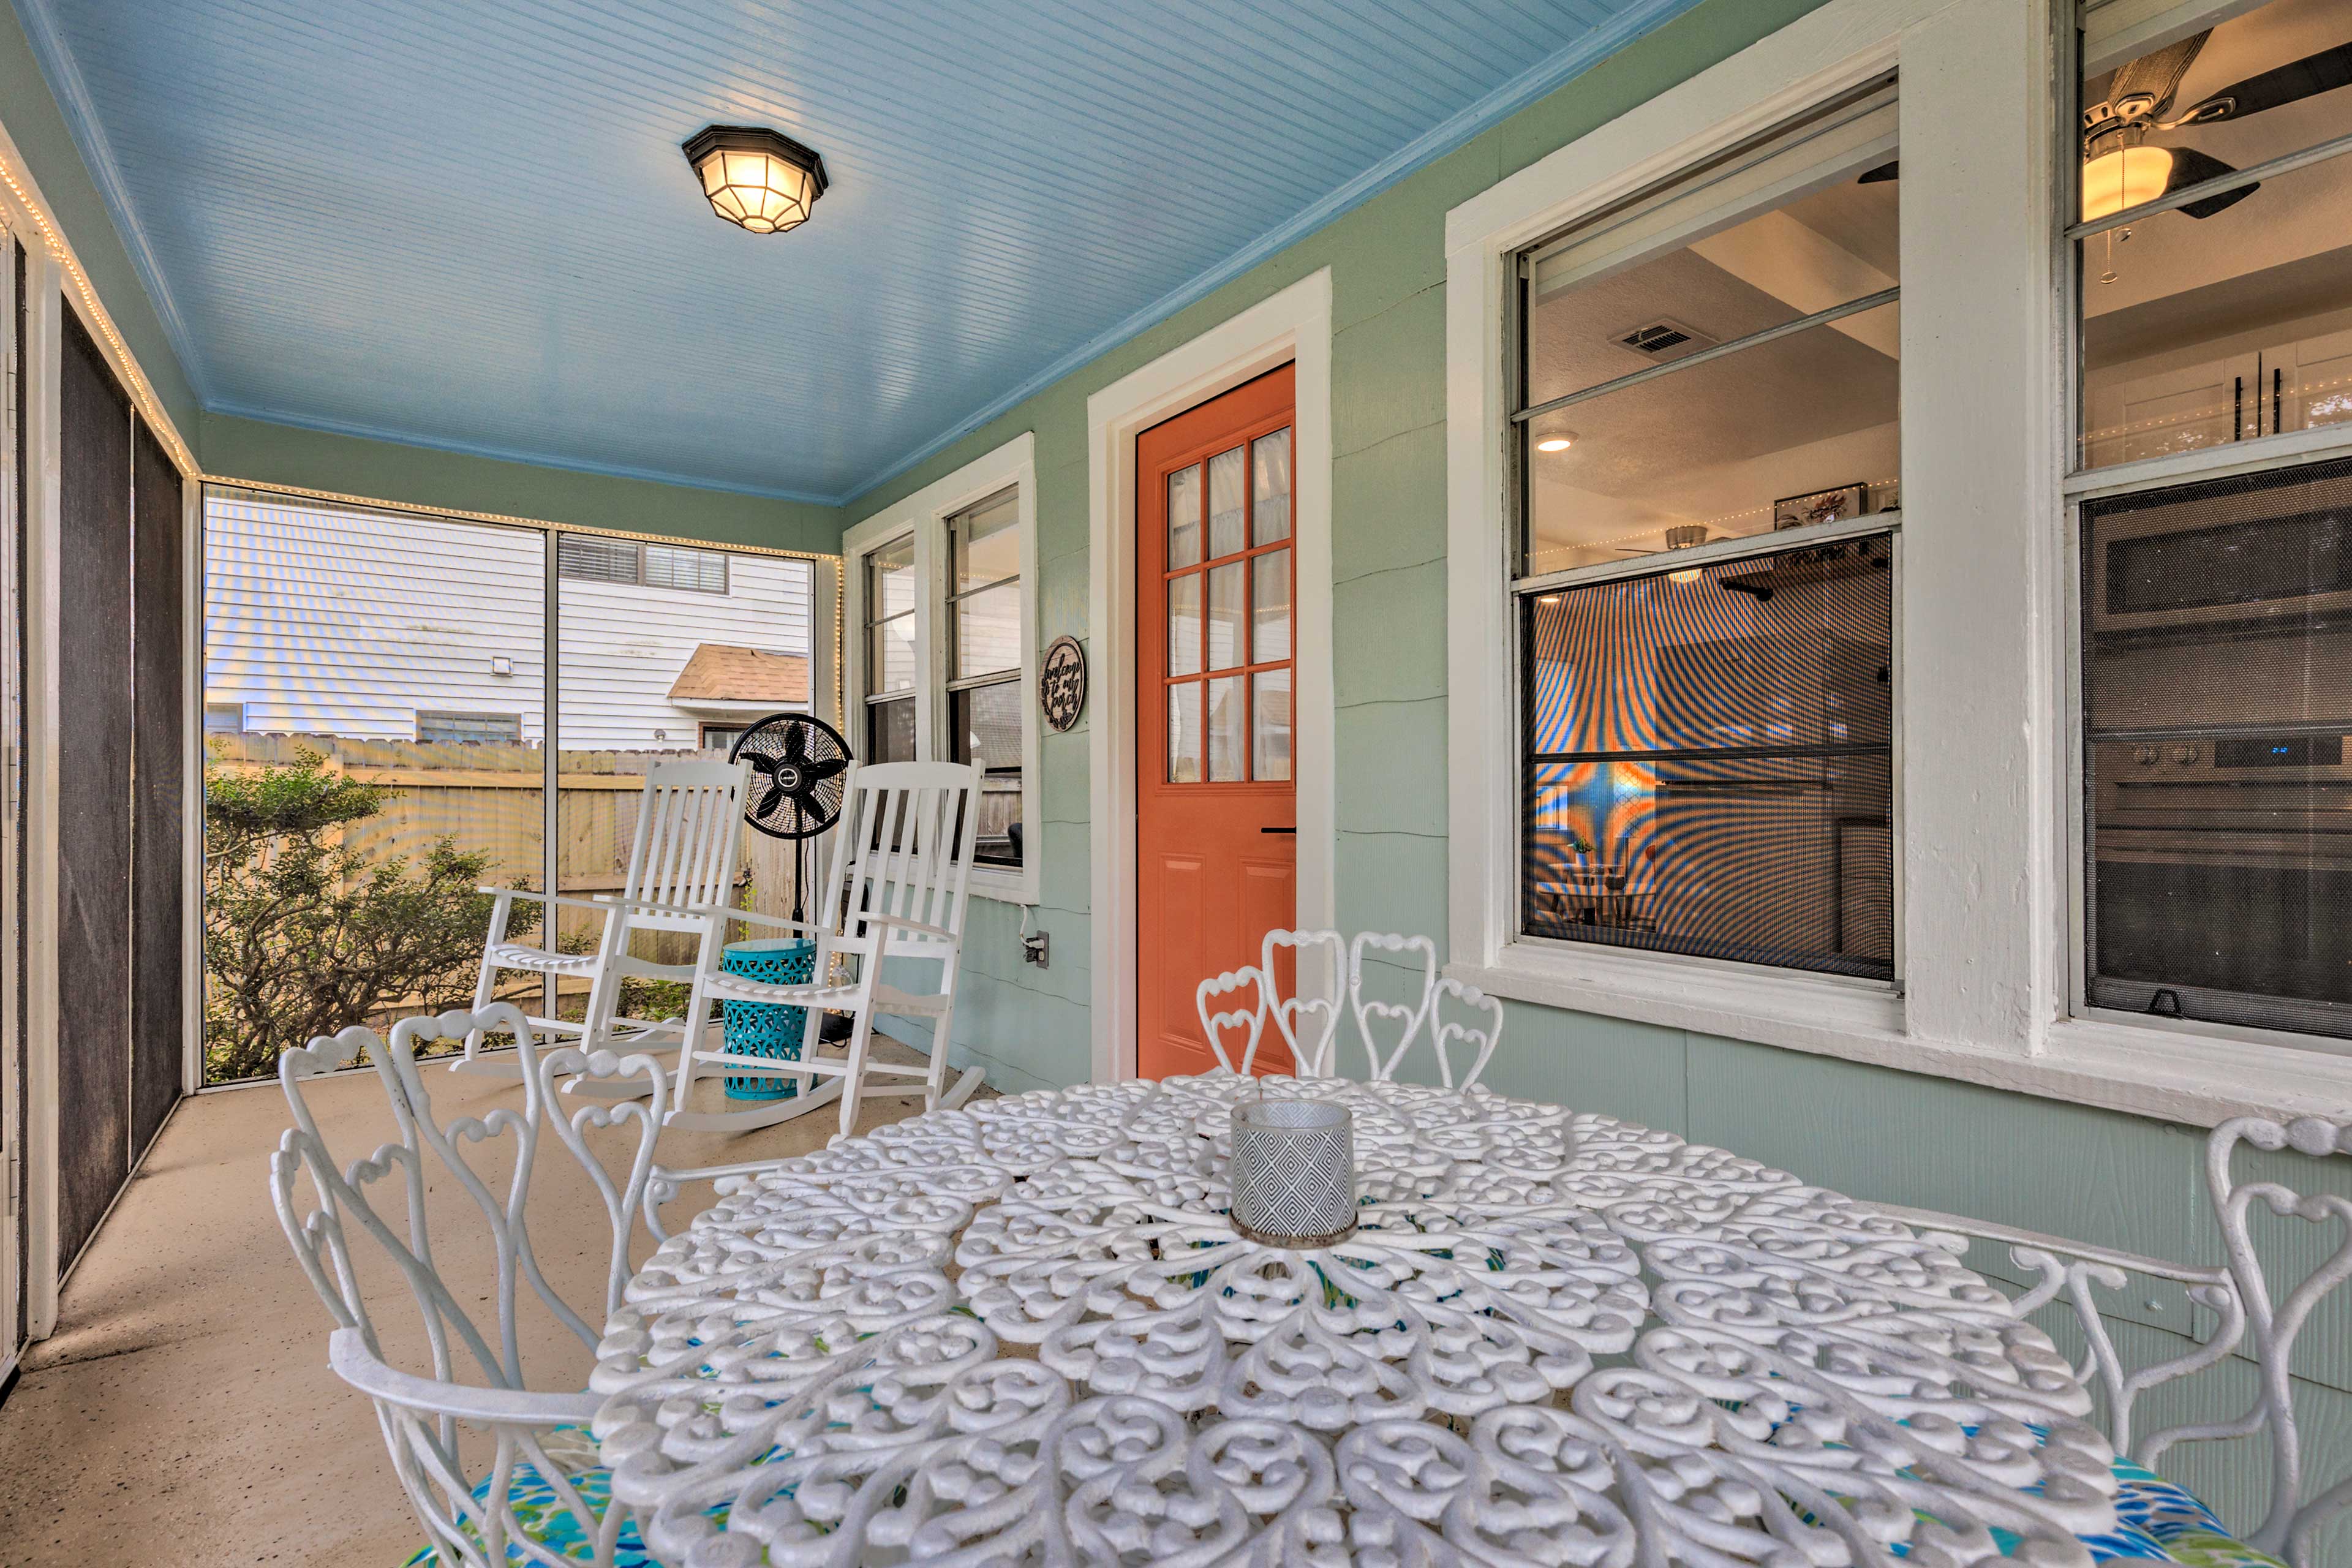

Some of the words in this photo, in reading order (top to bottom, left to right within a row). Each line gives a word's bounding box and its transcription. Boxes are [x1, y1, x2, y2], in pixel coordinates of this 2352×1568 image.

[1046, 653, 1080, 683] welcome
[1050, 679, 1060, 698] to
[1050, 692, 1078, 714] porch
